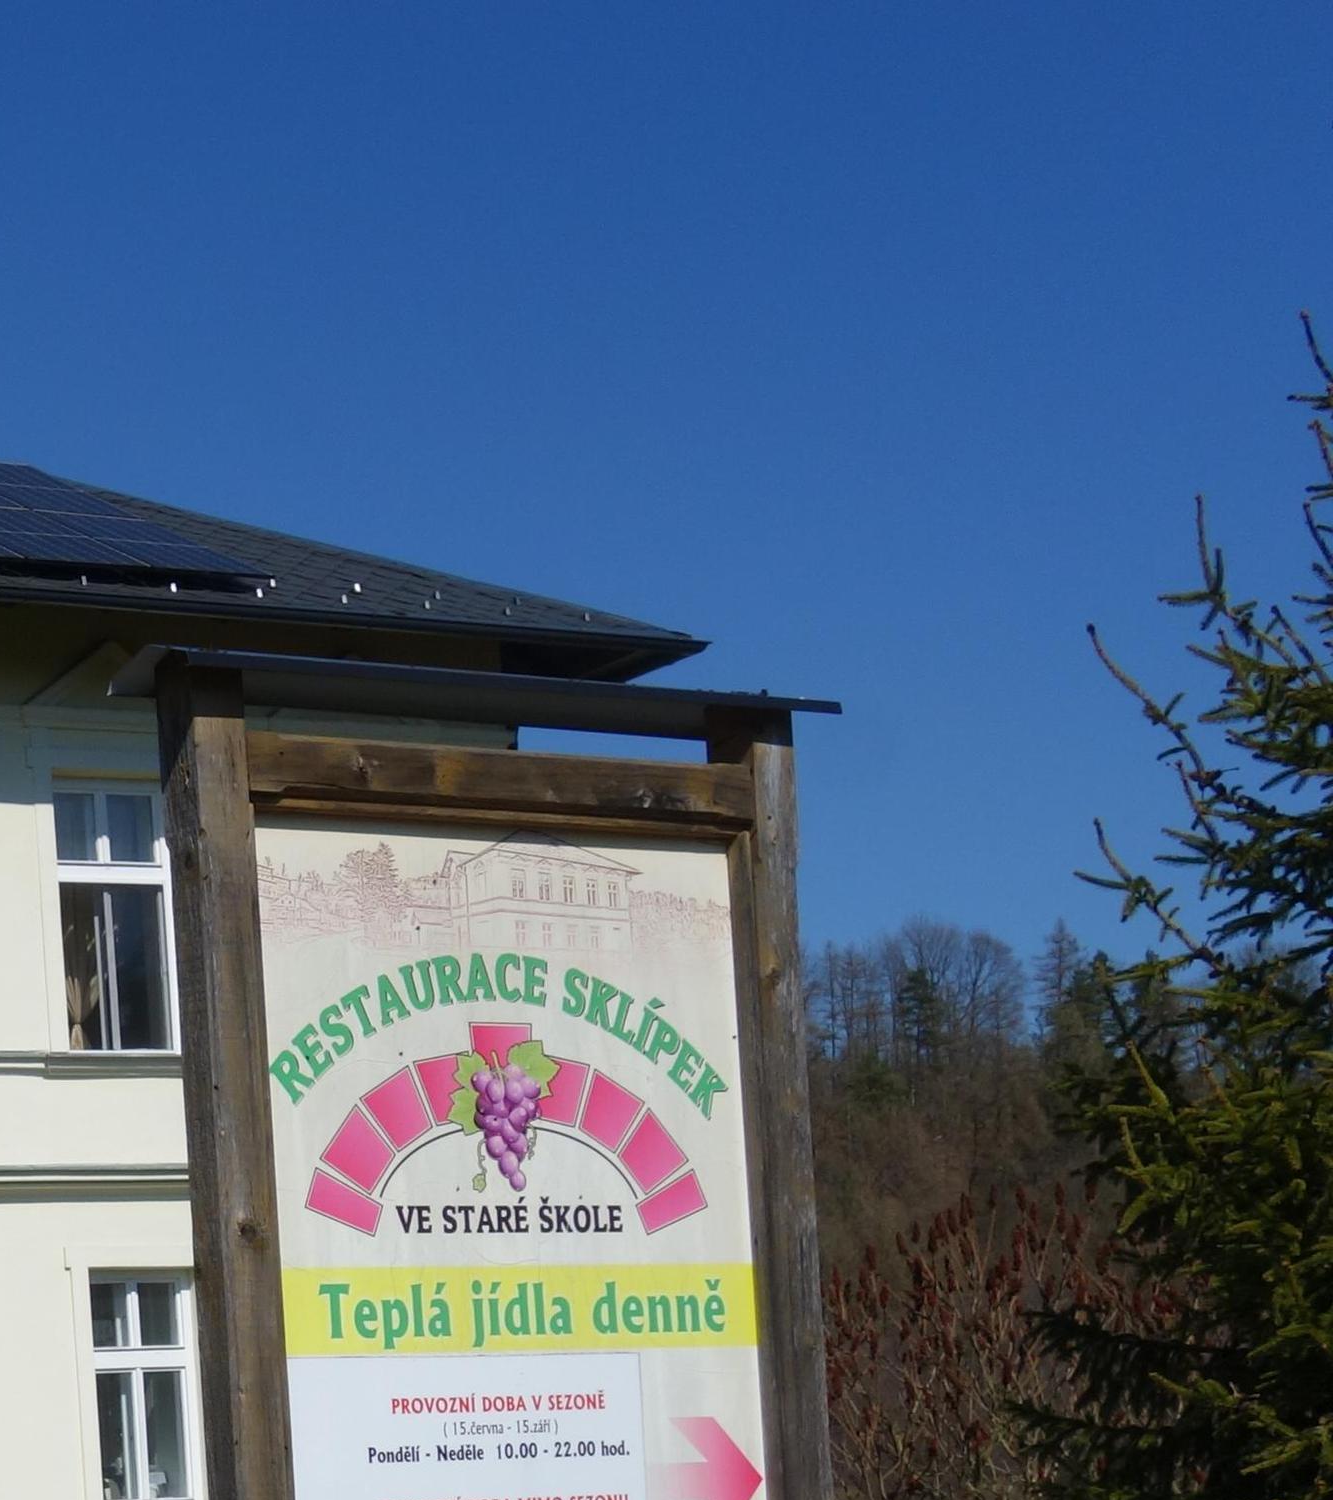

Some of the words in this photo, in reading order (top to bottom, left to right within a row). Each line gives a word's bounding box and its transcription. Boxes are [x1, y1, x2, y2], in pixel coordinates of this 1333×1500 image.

[268, 953, 548, 1105] RESTAURACE
[562, 968, 729, 1121] SKLÍPEK
[396, 1206, 432, 1233] VE
[443, 1197, 529, 1233] STARÉ
[539, 1197, 623, 1233] ŠKOLE
[319, 1282, 451, 1349] Teplá
[472, 1279, 573, 1347] jídla
[592, 1279, 726, 1335] denně
[391, 1393, 476, 1414] PROVOZNÍ
[483, 1396, 527, 1412] DOBA
[532, 1395, 542, 1410] V
[548, 1390, 606, 1410] SEZONĚ
[453, 1421, 504, 1436] 15.června
[368, 1445, 420, 1463] Pondělí
[437, 1444, 484, 1462] Neděle
[496, 1443, 538, 1460] 10.00
[554, 1441, 596, 1458] 22.00
[601, 1440, 630, 1457] hod.
